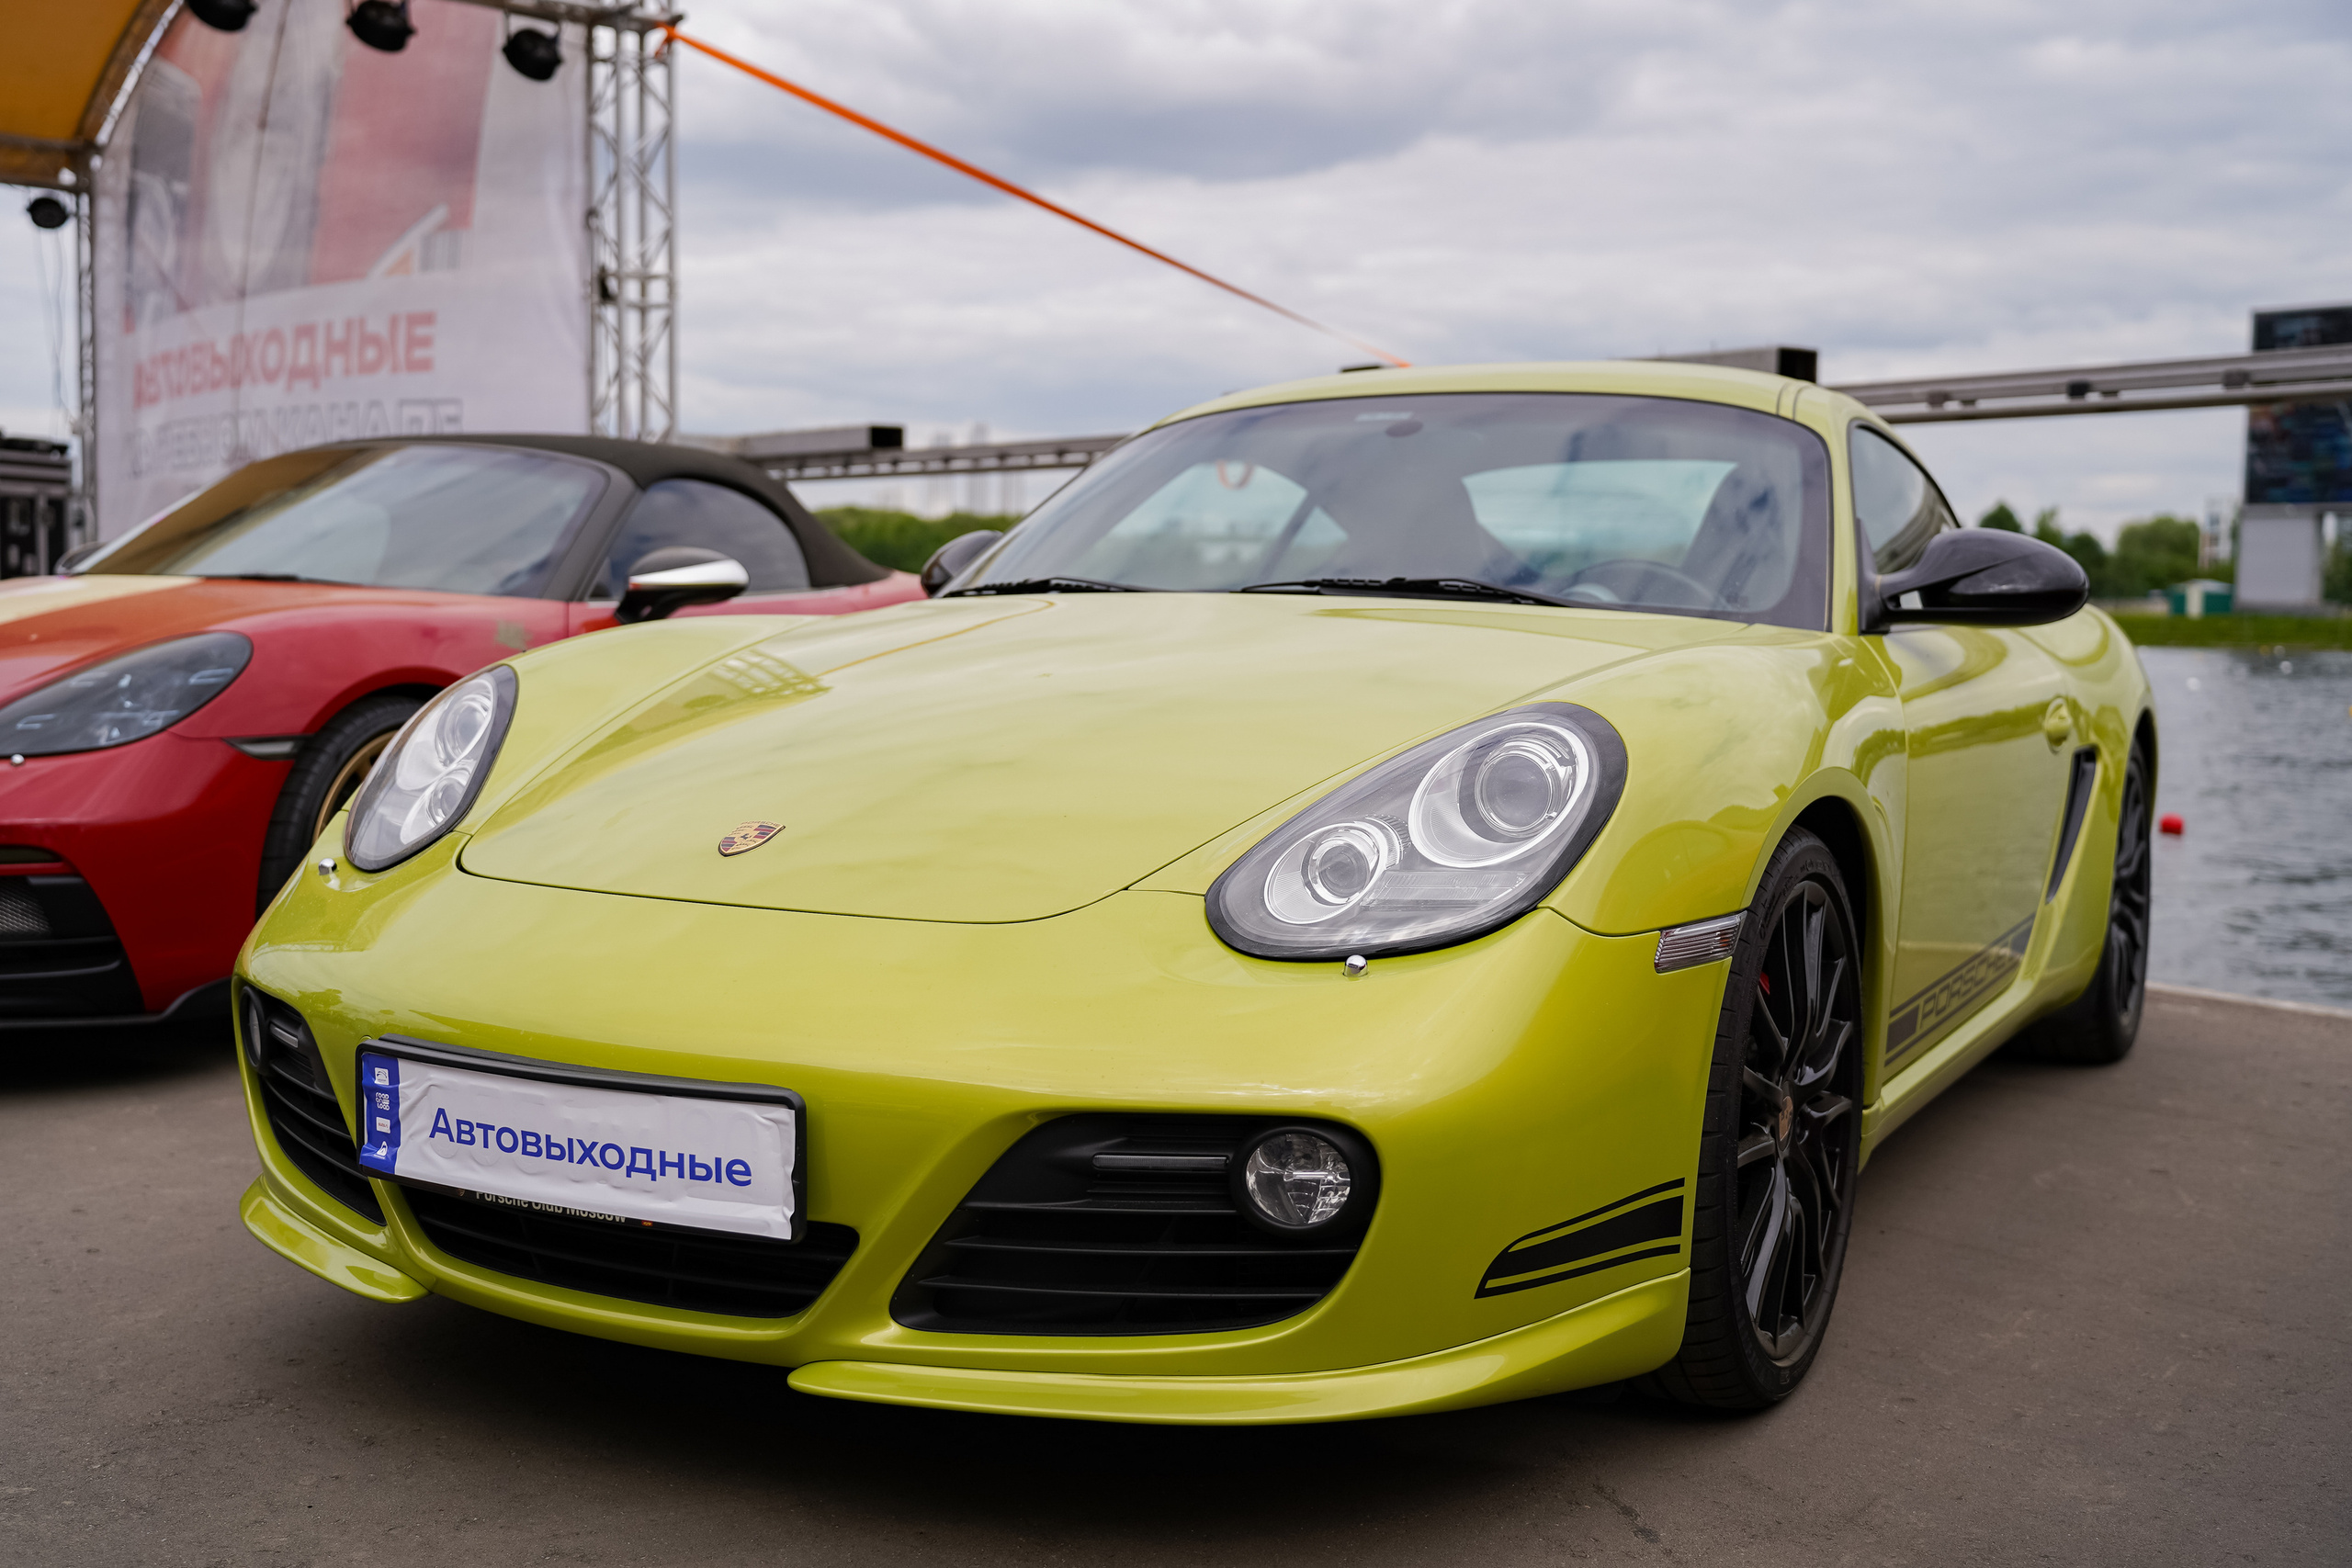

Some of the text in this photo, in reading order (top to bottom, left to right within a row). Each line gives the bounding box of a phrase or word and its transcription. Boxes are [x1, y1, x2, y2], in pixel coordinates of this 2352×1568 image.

[132, 310, 437, 411] АВТОВЫХОДНЫЕ
[1919, 938, 2010, 1029] PORSCHE
[428, 1107, 753, 1188] Автовыходные
